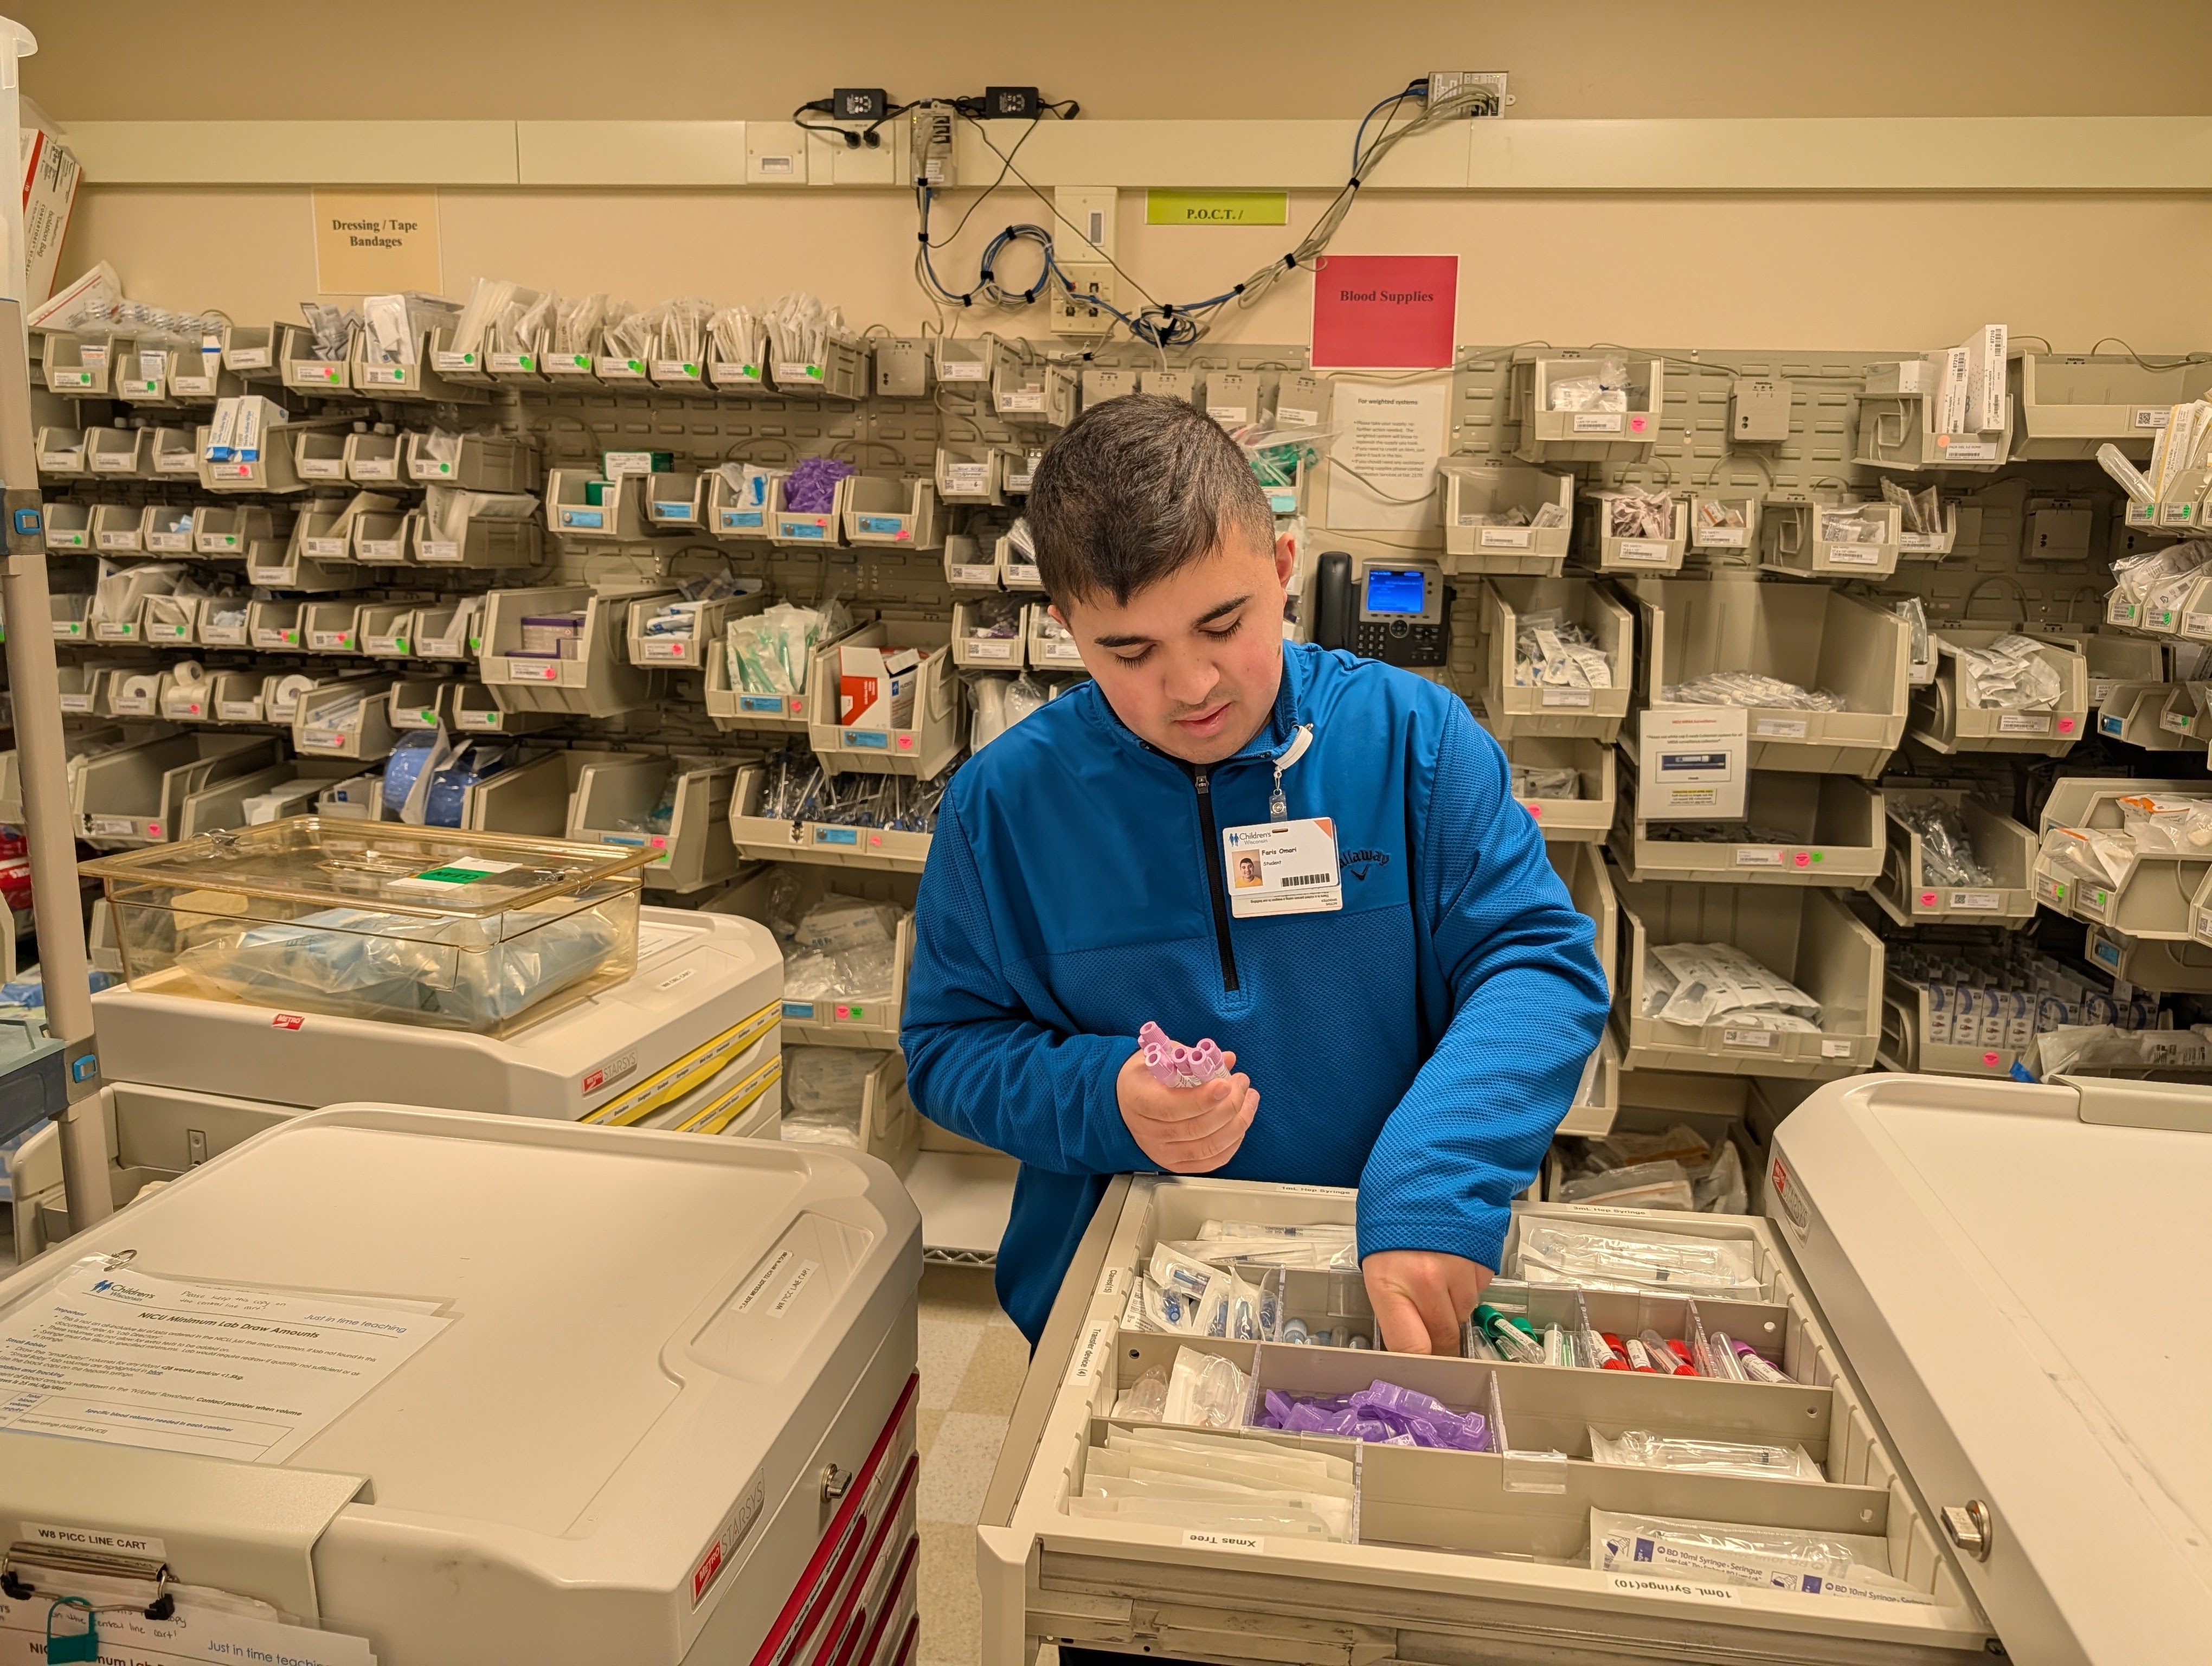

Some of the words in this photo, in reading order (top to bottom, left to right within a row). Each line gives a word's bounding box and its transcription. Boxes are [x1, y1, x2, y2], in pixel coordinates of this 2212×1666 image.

[1187, 209, 1236, 220] P.O.C.T.
[1238, 209, 1244, 220] /
[332, 219, 380, 233] Dressing
[382, 220, 387, 232] /
[390, 220, 417, 233] Tape
[350, 235, 402, 248] Bandages
[37, 242, 47, 258] Bag
[1340, 291, 1376, 302] Blood
[1380, 291, 1433, 304] Supplies
[1239, 831, 1271, 841] Children's
[1340, 849, 1390, 868] allaway
[277, 1015, 301, 1023] METRO
[587, 1073, 602, 1084] METRO
[603, 1052, 635, 1080] STARSYS
[750, 1278, 767, 1297] MESSAGE
[763, 1268, 774, 1280] TECH
[1102, 1270, 1117, 1293] Claves(15)
[110, 1291, 143, 1302] Wisconsin
[111, 1285, 155, 1299] Children's
[54, 1306, 87, 1316] Important
[55, 1321, 90, 1330] document,
[138, 1312, 169, 1321] NICU
[166, 1316, 217, 1325] Minimum
[240, 1324, 271, 1332] Draw
[271, 1328, 320, 1338] Amounts
[361, 1321, 407, 1333] teaching
[1087, 1328, 1102, 1351] Transfer
[1082, 1349, 1096, 1367] device
[83, 1368, 109, 1376] heparin
[105, 1364, 140, 1373] highlighted
[196, 1369, 220, 1377] and/or
[311, 1364, 343, 1373] sufficient
[1077, 1367, 1086, 1377] (4)
[73, 1382, 108, 1391] withdrawn
[224, 1401, 255, 1409] provider
[699, 1547, 719, 1582] METRO
[722, 1481, 762, 1556] STARSYS
[38, 1529, 56, 1539] W8
[59, 1531, 86, 1542] PICC
[89, 1535, 114, 1546] LINE
[117, 1539, 146, 1550] CART
[1189, 1534, 1218, 1544] Tree
[1222, 1537, 1256, 1548] Xmas
[1680, 1552, 1697, 1560] 10ml
[1699, 1556, 1726, 1568] Syringe
[1731, 1563, 1763, 1575] Seringue
[1614, 1579, 1692, 1594] Syringe(10)
[1695, 1587, 1732, 1598] 10mL
[1835, 1585, 1847, 1593] BD
[1849, 1588, 1867, 1597] 10ml
[776, 1635, 792, 1662] Sutures
[794, 1605, 810, 1631] Butterfly
[809, 1579, 825, 1604] Needles
[839, 1527, 852, 1552] Needles
[168, 1616, 187, 1628] opy
[130, 1623, 145, 1633] line
[154, 1630, 177, 1639] cart!
[30, 1643, 48, 1654] NIC
[208, 1640, 229, 1653] Just
[233, 1644, 243, 1656] in
[247, 1648, 272, 1662] time
